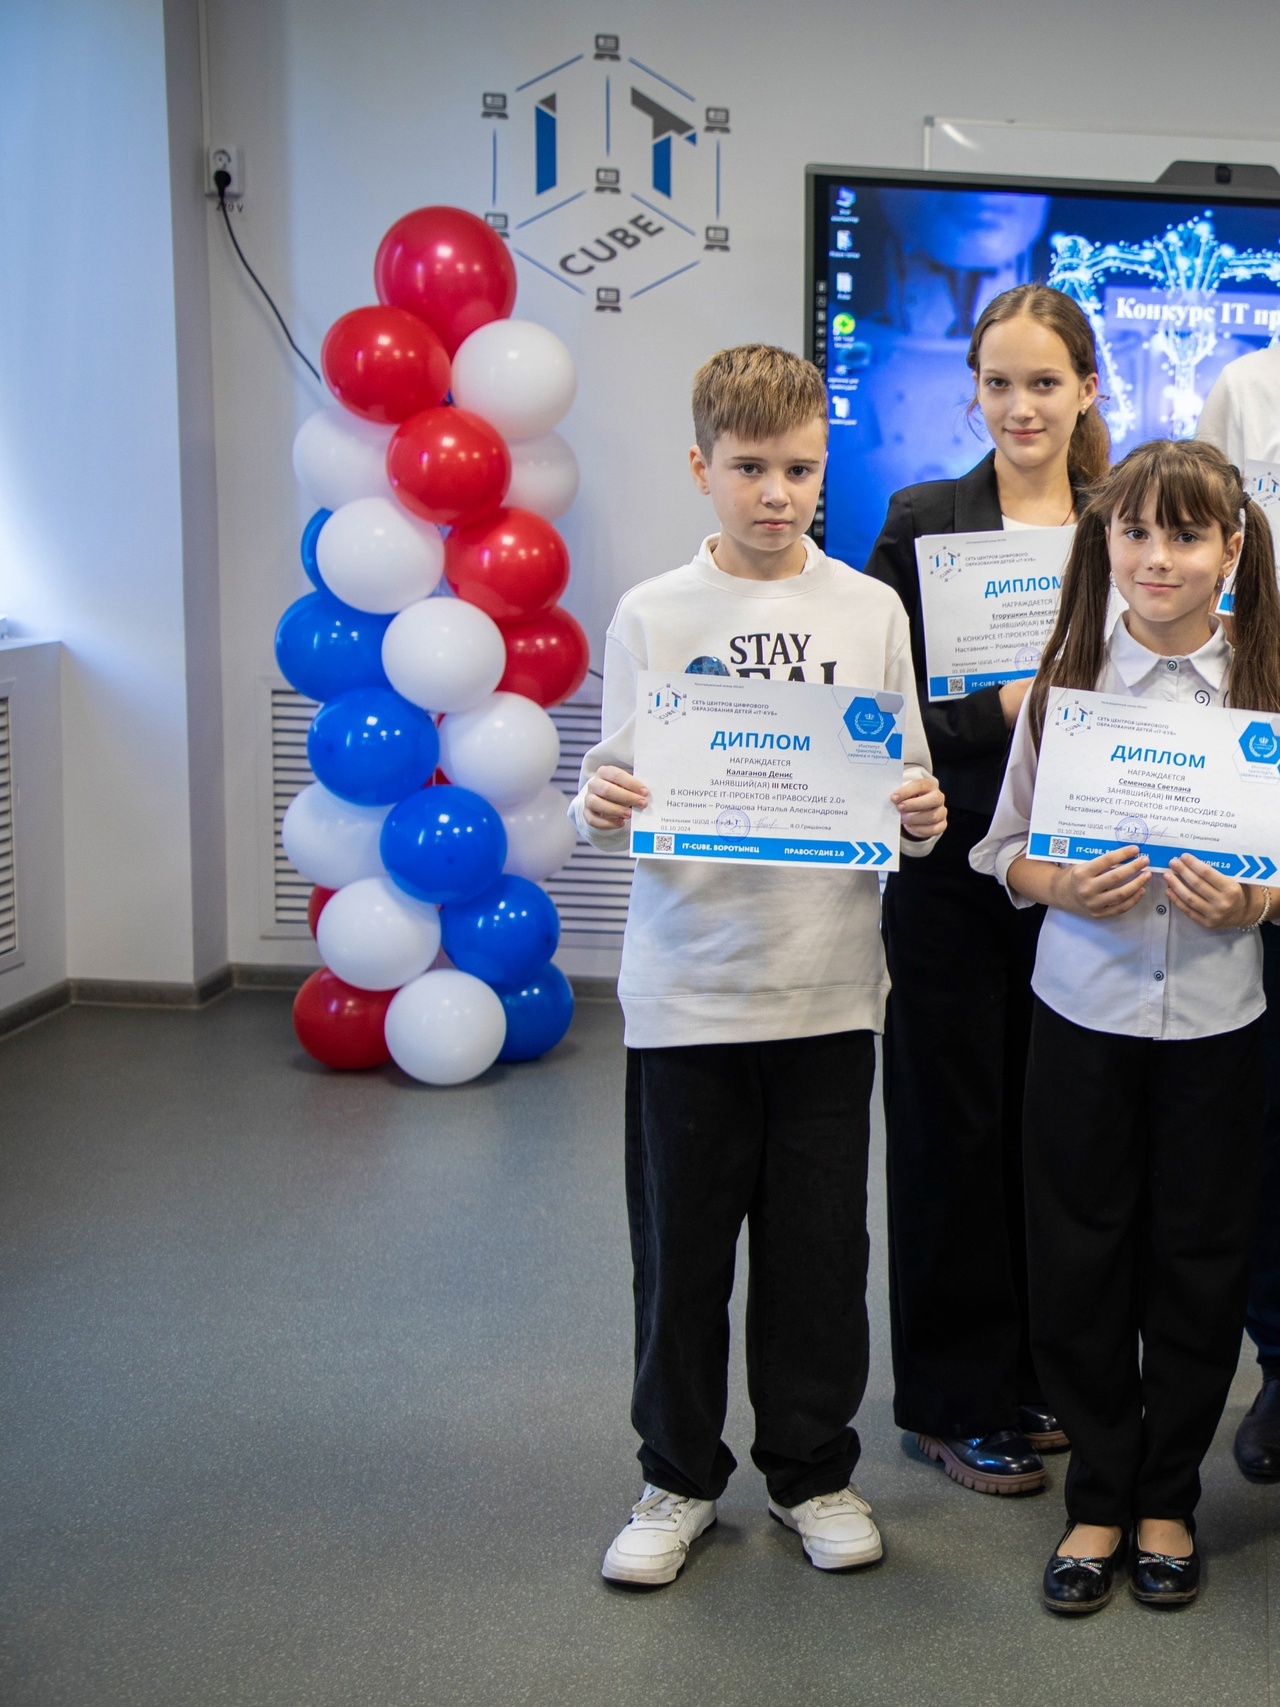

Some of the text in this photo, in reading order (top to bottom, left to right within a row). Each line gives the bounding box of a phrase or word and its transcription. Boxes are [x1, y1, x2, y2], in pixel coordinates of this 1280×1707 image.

[557, 213, 666, 278] CUBE
[1116, 297, 1215, 327] Конкурс
[1220, 302, 1250, 325] IT
[1002, 598, 1053, 608] НАГРАЖДАЕТСЯ
[730, 633, 812, 665] STAY
[733, 702, 770, 710] ЦИФРОВОГО
[710, 731, 810, 751] ДИПЛОМ
[729, 757, 791, 767] НАГРАЖДАЕТСЯ
[1110, 745, 1206, 769] ДИПЛОМ
[726, 768, 793, 779] Калаганов Денис
[1127, 769, 1186, 781] НАГРАЖДАЕТСЯ
[710, 778, 770, 790] ЗАНЯВШИЙ(АЯ)
[780, 782, 809, 791] МЕСТО
[1118, 778, 1192, 793] Семенова Светлана
[677, 789, 718, 798] КОНКУРСЕ
[719, 791, 770, 800] IT-ПРОЕКТОВ
[771, 794, 828, 804] «ПРАВОСУДИЕ
[1107, 786, 1164, 801] ЗАНЯВШИЙ(АЯ)
[1173, 795, 1201, 804] МЕСТО
[666, 800, 848, 816] Наставник Ромашова Наталья Александровна
[1075, 794, 1114, 805] КОНКУРСЕ
[1115, 798, 1163, 810] IT-ПРОЕКТОВ
[1164, 805, 1218, 817] «ПРАВОСУДИЕ
[1064, 804, 1237, 829] Наставник Ромашова Наталья Александровна
[713, 844, 760, 853] ВОРОТЫНЕЦ
[784, 848, 834, 857] ПРАВОСУДИЕ
